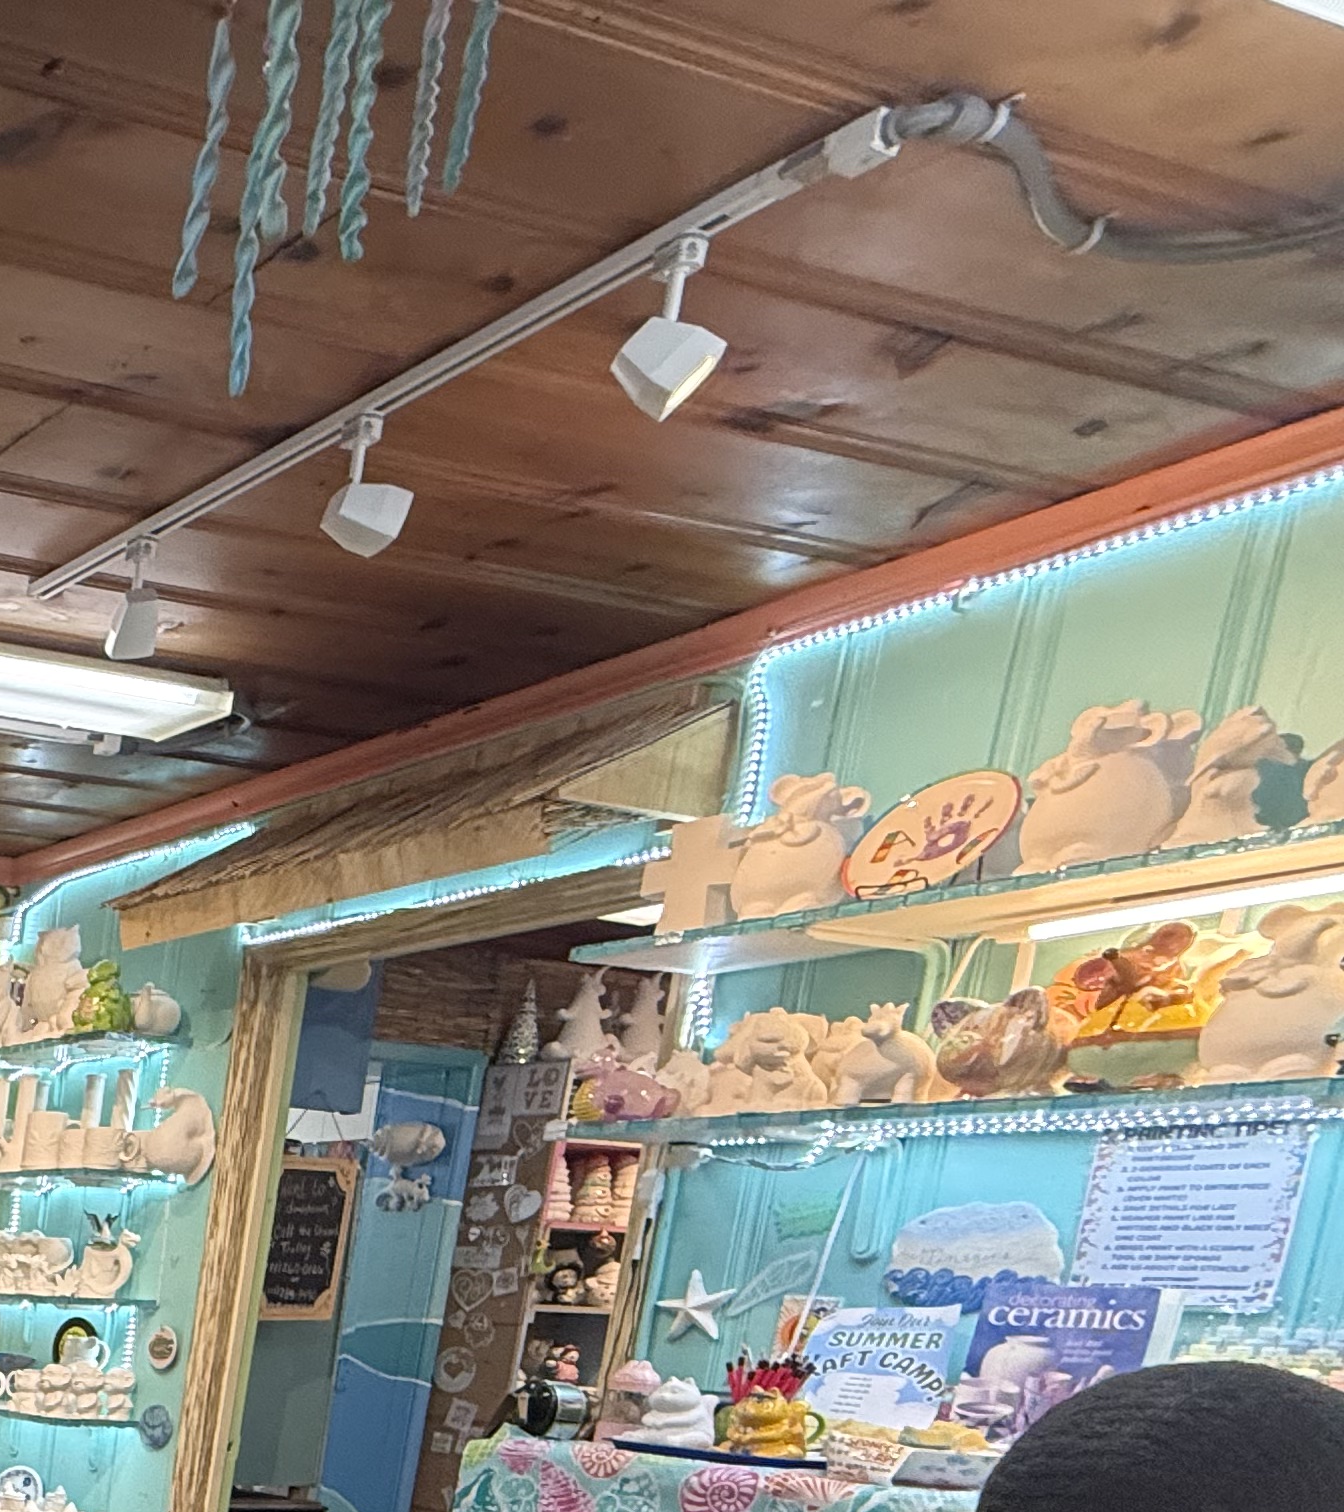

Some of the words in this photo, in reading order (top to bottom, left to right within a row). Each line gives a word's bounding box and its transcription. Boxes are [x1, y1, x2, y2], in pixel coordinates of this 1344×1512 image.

[1009, 1292, 1097, 1312] decorating
[988, 1299, 1147, 1330] ceramics
[828, 1331, 944, 1350] SUMMER
